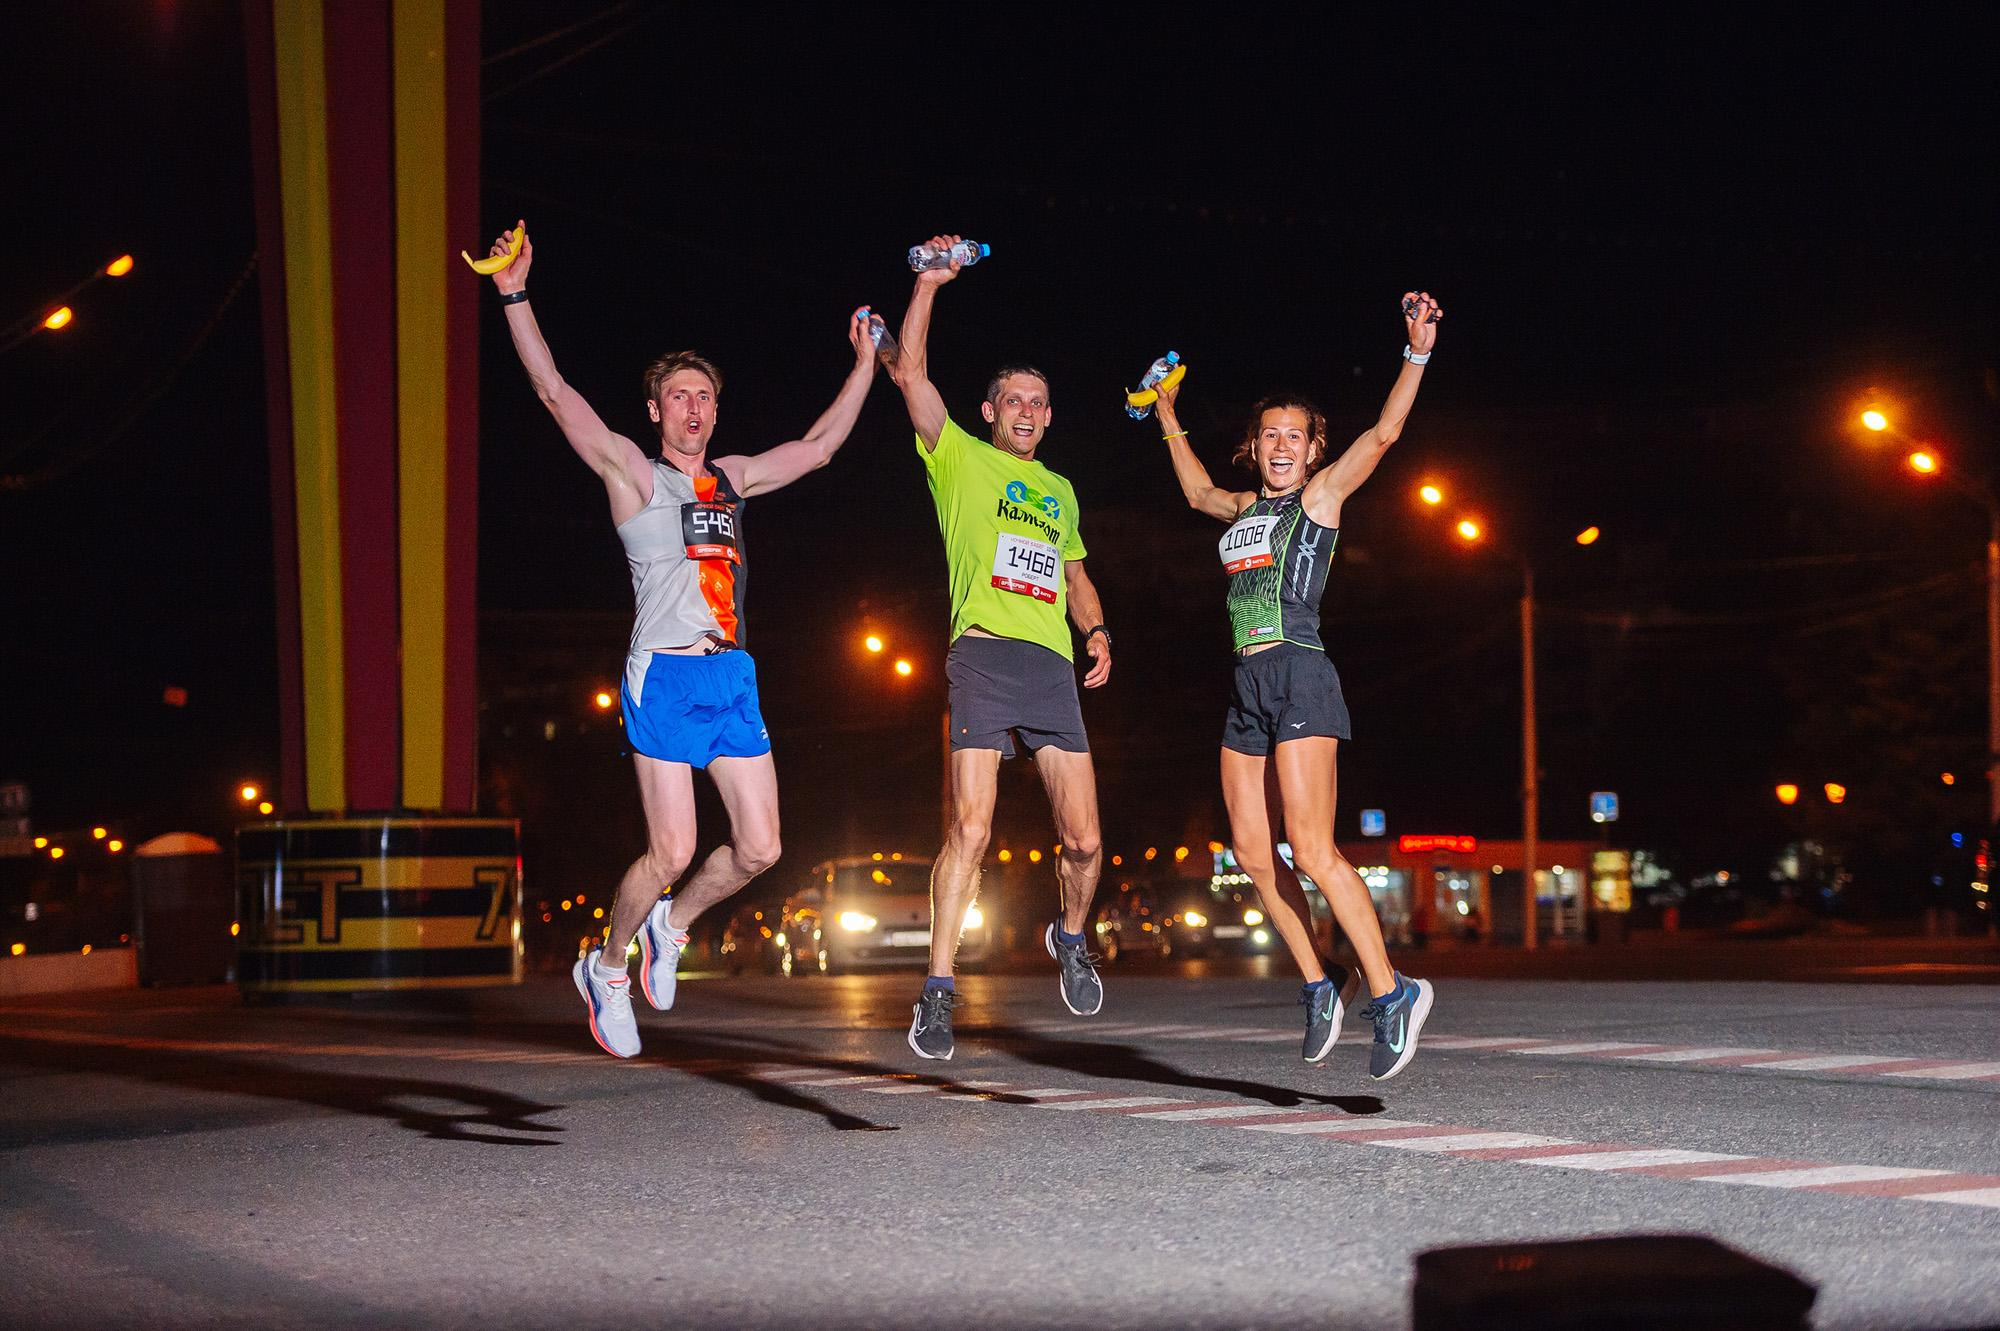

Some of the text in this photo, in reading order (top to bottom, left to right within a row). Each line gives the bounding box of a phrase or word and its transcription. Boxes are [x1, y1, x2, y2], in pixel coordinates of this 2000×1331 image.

[692, 511, 736, 539] 5451
[1224, 524, 1267, 552] 1008
[1007, 546, 1056, 579] 1468
